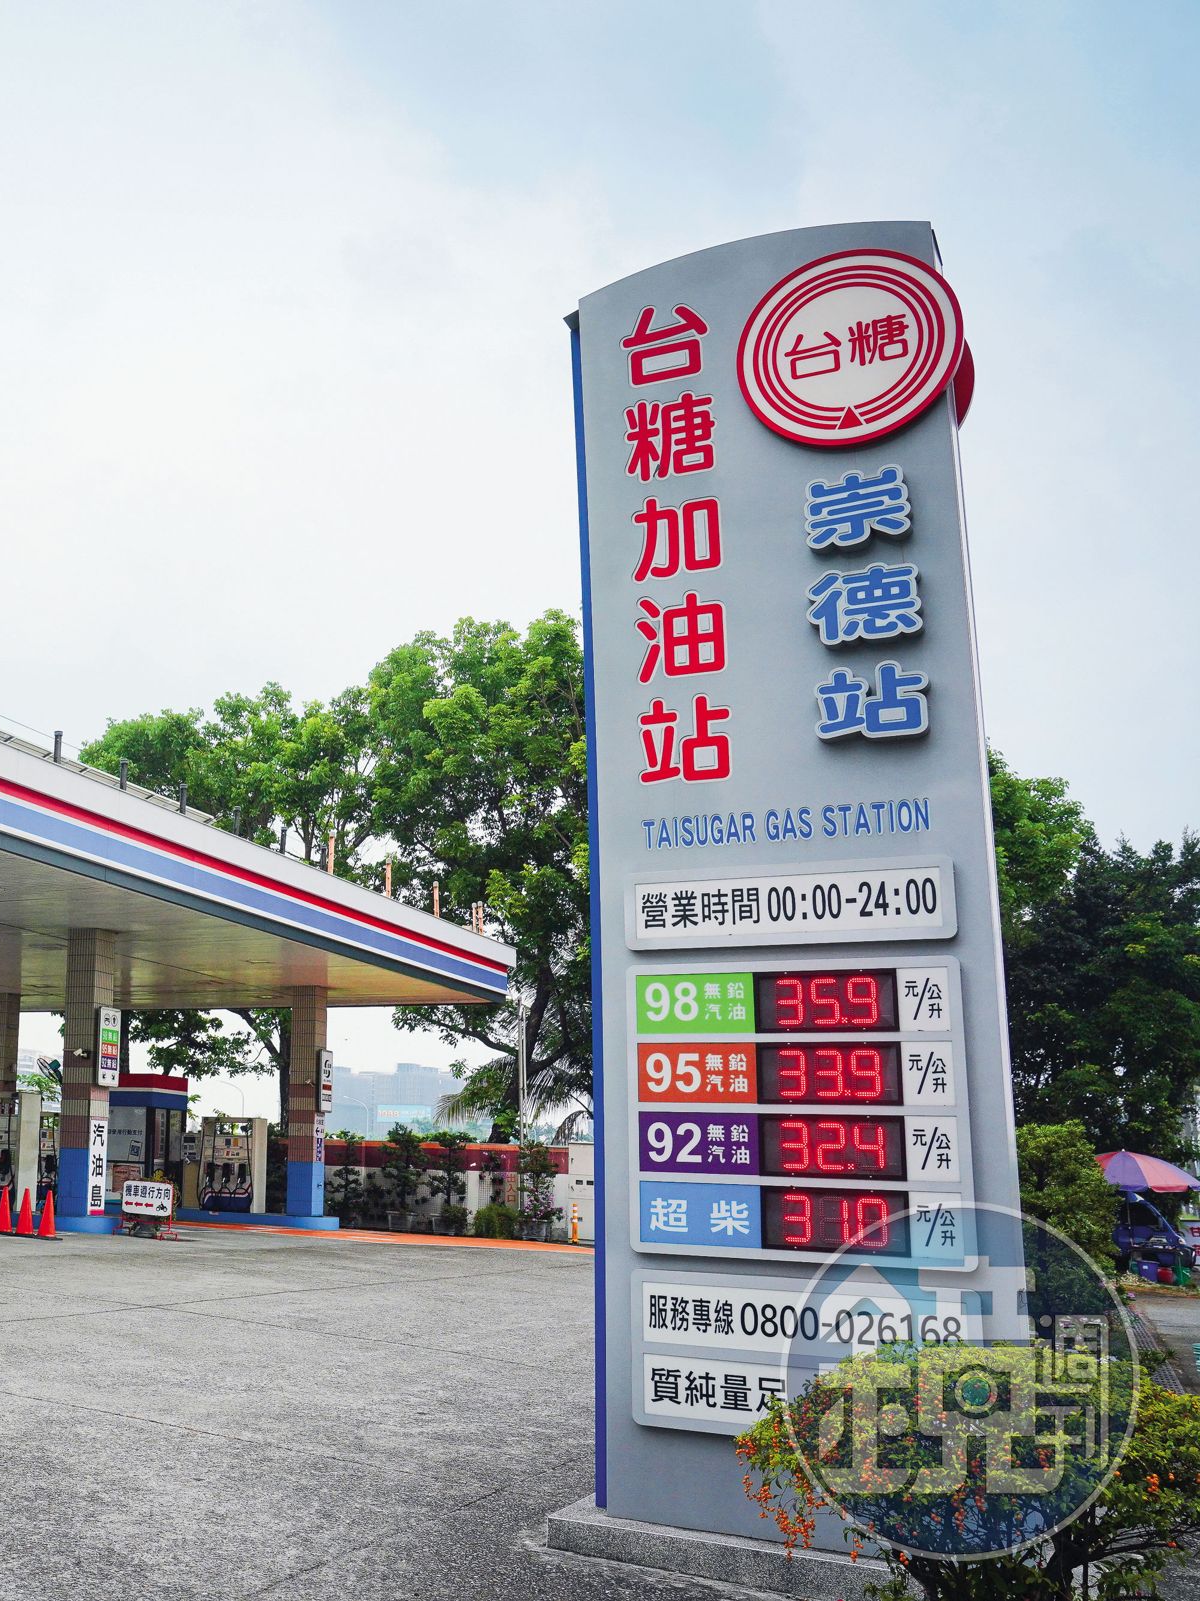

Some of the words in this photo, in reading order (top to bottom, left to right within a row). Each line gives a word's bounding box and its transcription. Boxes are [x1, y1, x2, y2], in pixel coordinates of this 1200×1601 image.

[784, 314, 909, 380] 台糖
[620, 303, 731, 784] 台糖加油站
[806, 466, 929, 740] 崇德站
[642, 811, 756, 849] TAISUGAR
[766, 807, 812, 841] GAS
[822, 798, 930, 837] STATION
[641, 888, 760, 929] 營業時間
[767, 877, 937, 921] 00:00-24:00
[645, 982, 698, 1021] 98
[775, 977, 879, 1025] 35.9
[645, 1053, 701, 1092] 95
[779, 1050, 882, 1097] 33.9
[91, 1123, 105, 1207] 汽油島
[647, 1122, 702, 1163] 92
[781, 1121, 885, 1170] 32.4
[649, 1197, 750, 1235] 超柴
[648, 1294, 734, 1336] 服務專線
[740, 1302, 962, 1346] 0800-026168
[651, 1367, 787, 1412] 質純量足
